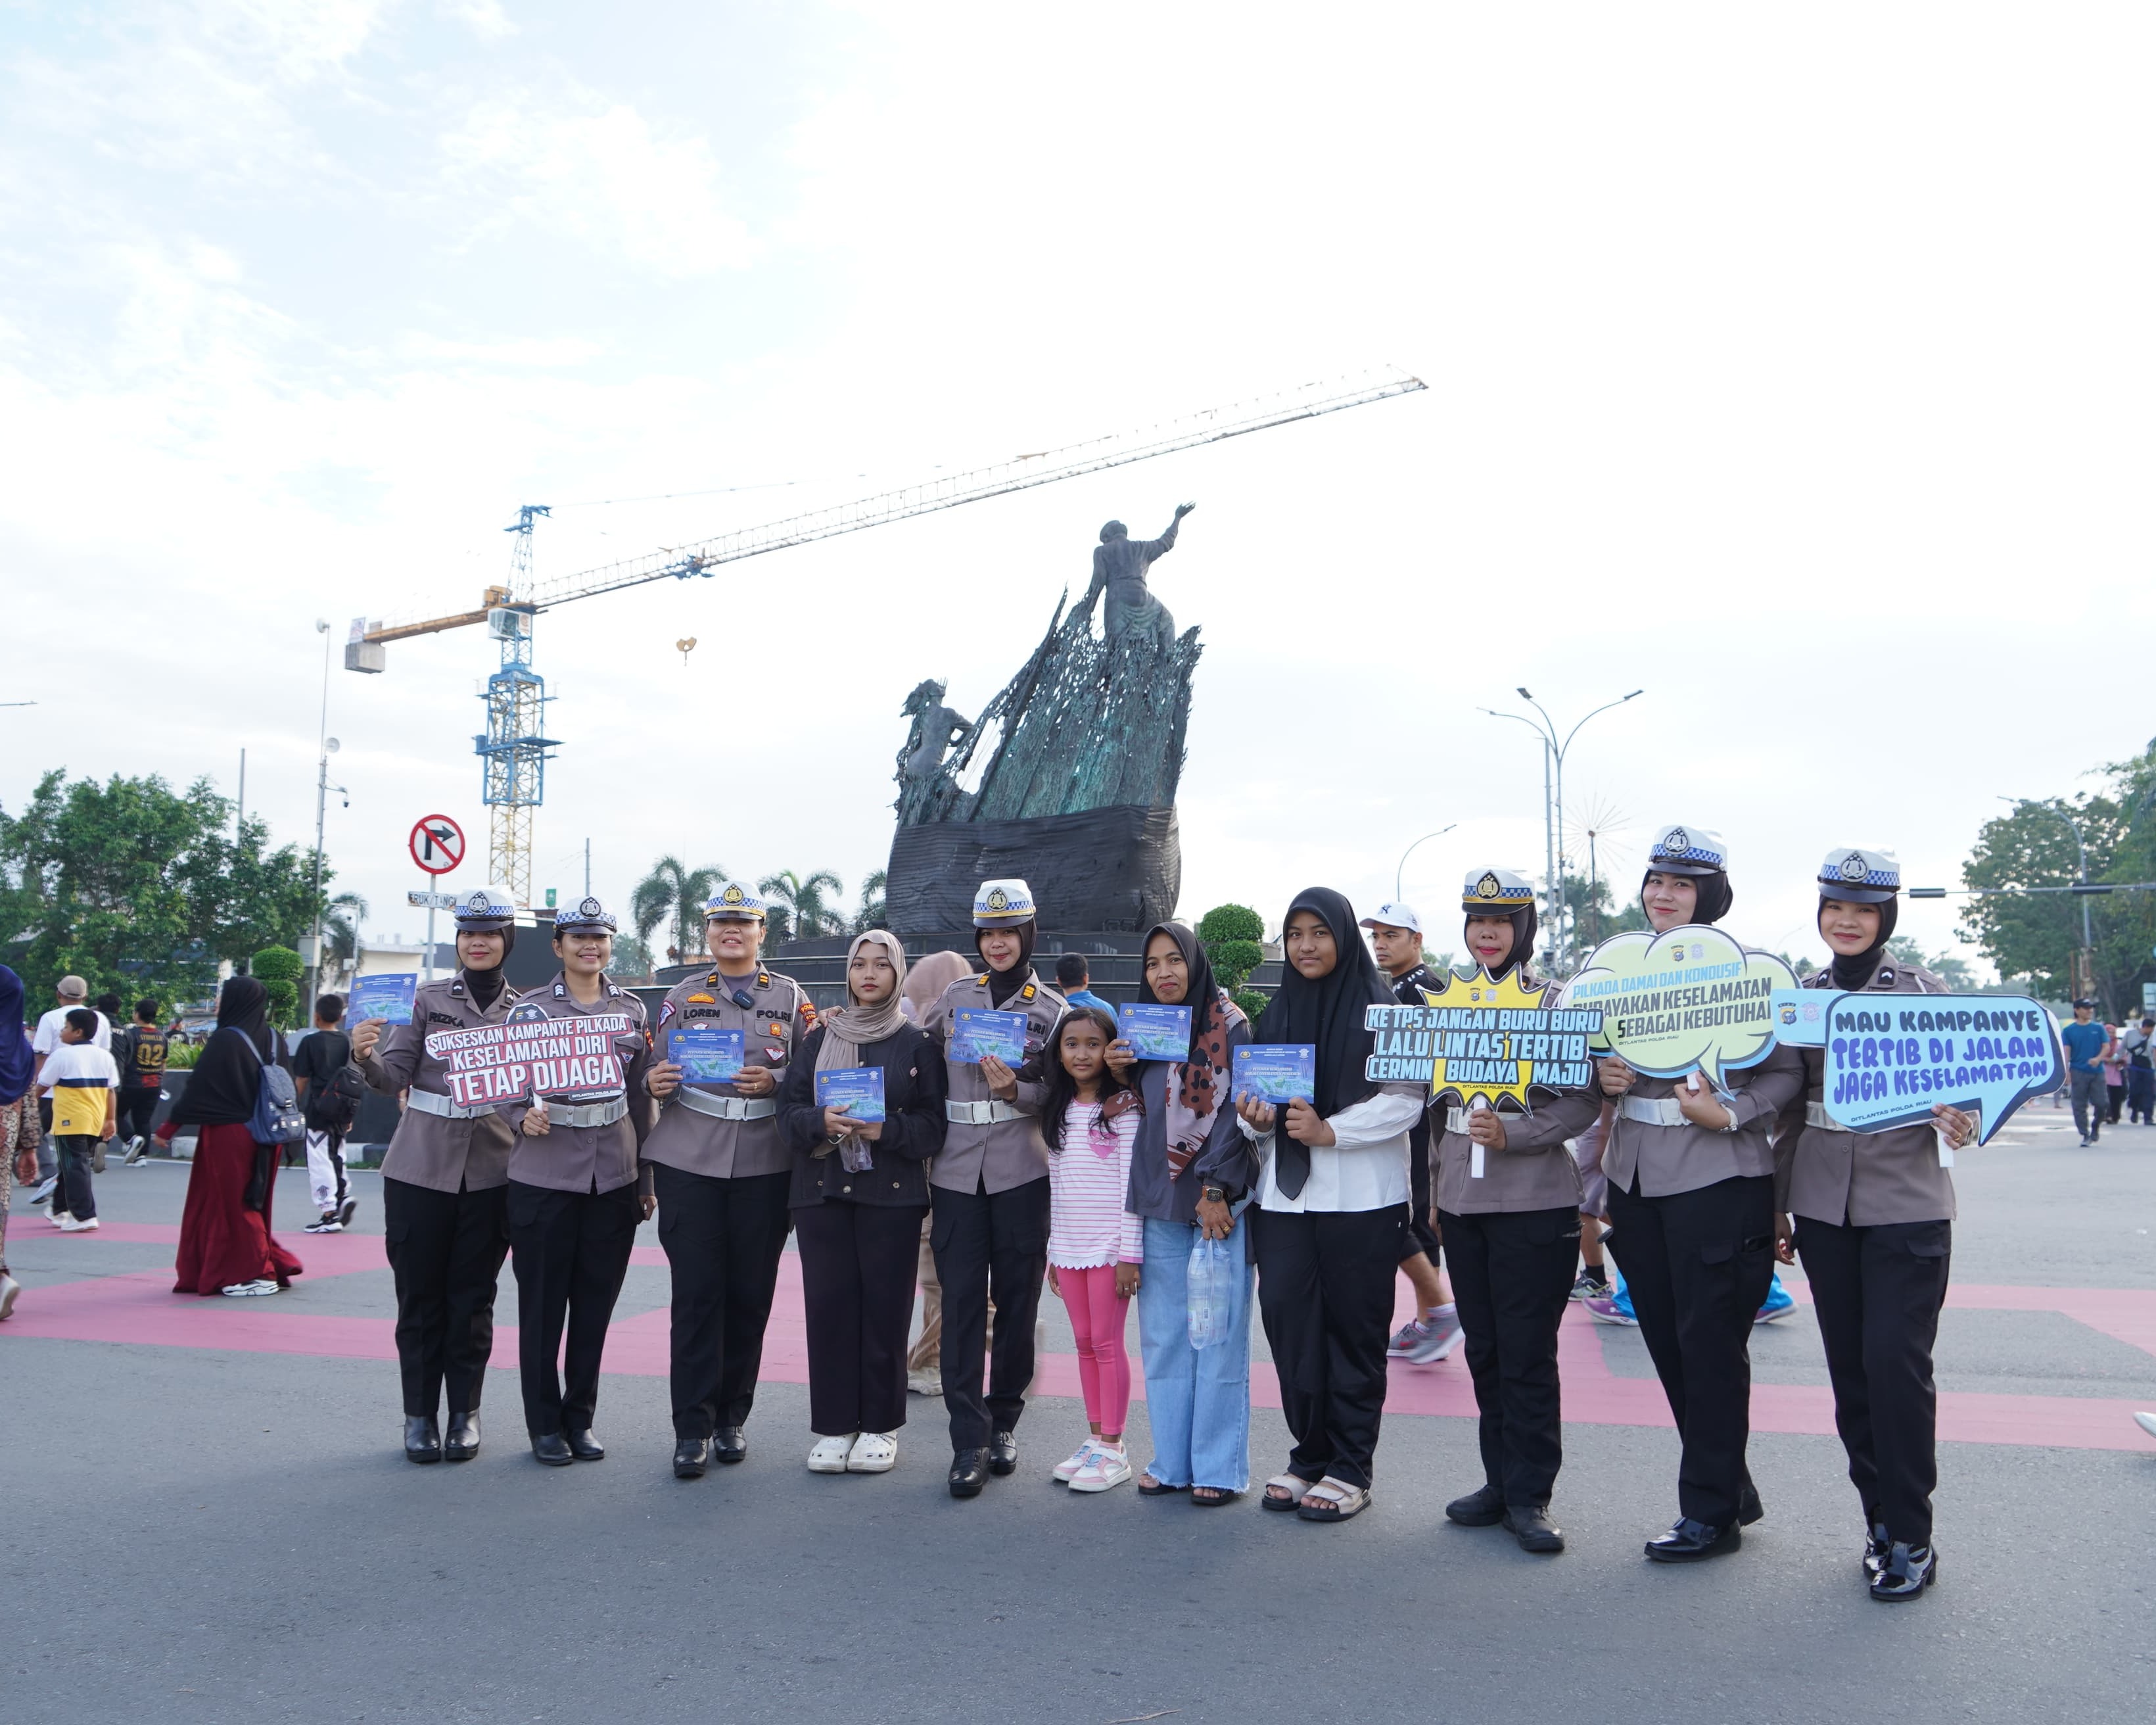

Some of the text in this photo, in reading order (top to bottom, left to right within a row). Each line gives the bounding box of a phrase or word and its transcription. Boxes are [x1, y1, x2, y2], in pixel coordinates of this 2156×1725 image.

[1573, 961, 1743, 999] PILKADA DAMAI DAN KONDUSIF
[1664, 977, 1772, 1010] KESELAMATAN
[429, 1012, 465, 1029] RIZKA
[684, 1008, 720, 1019] LOREN
[757, 1010, 792, 1022] POLRI
[1367, 1008, 1601, 1032] KE TPS JANGAN BURU BURU
[1618, 1012, 1681, 1039] SEBAGAI
[1835, 1010, 2040, 1032] MAU KAMPANYE
[429, 1029, 504, 1052] SUKSESKAN
[507, 1020, 574, 1041] KAMPANYE
[576, 1017, 627, 1034] PILKADA
[1377, 1030, 1585, 1060] LALU LINTAS TERTIB
[137, 1043, 164, 1066] 02
[452, 1035, 607, 1071] KESELAMATAN DIRI
[1832, 1036, 2045, 1070] TERTIB DI JALAN
[448, 1056, 619, 1102] TETAP DIJAGA
[1369, 1058, 1588, 1085] CERMIN BUDAYA MAJU
[1833, 1060, 2048, 1105] JAGA KESELAMATAN
[1851, 1109, 1888, 1122] DITLANTAS
[1890, 1104, 1913, 1112] POLDA
